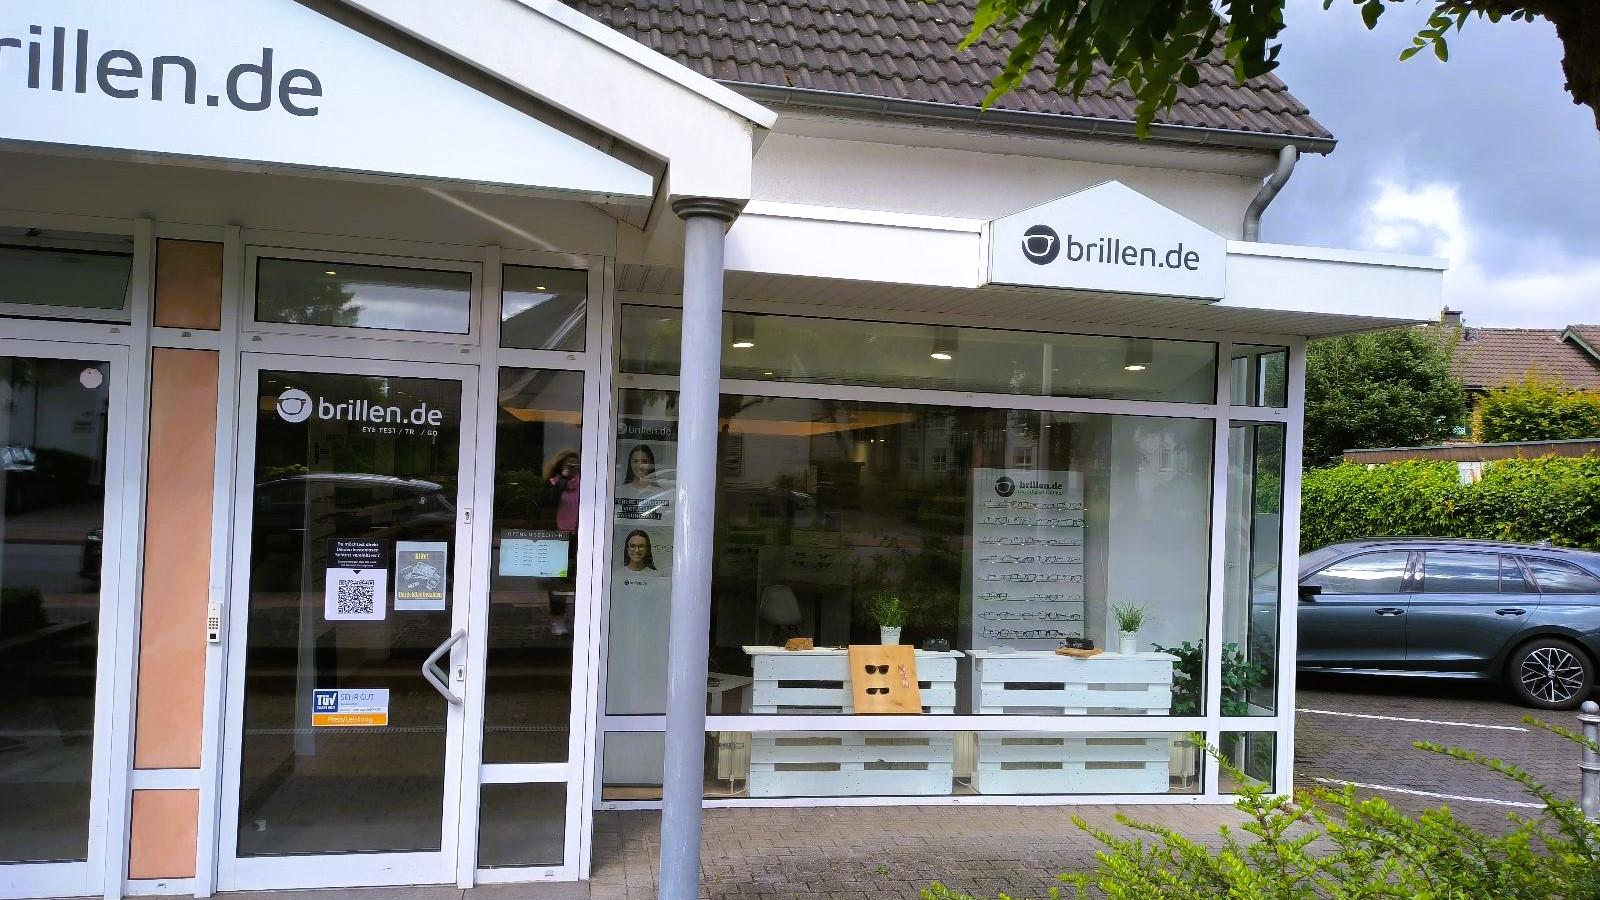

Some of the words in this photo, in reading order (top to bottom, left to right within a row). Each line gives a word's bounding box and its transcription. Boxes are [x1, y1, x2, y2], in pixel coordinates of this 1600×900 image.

[1066, 234, 1200, 271] brillen.de
[318, 396, 443, 426] brillen.de
[379, 427, 396, 435] TEST
[628, 425, 673, 436] brillen.de
[1019, 480, 1063, 490] brillen.de
[360, 693, 375, 701] GUT
